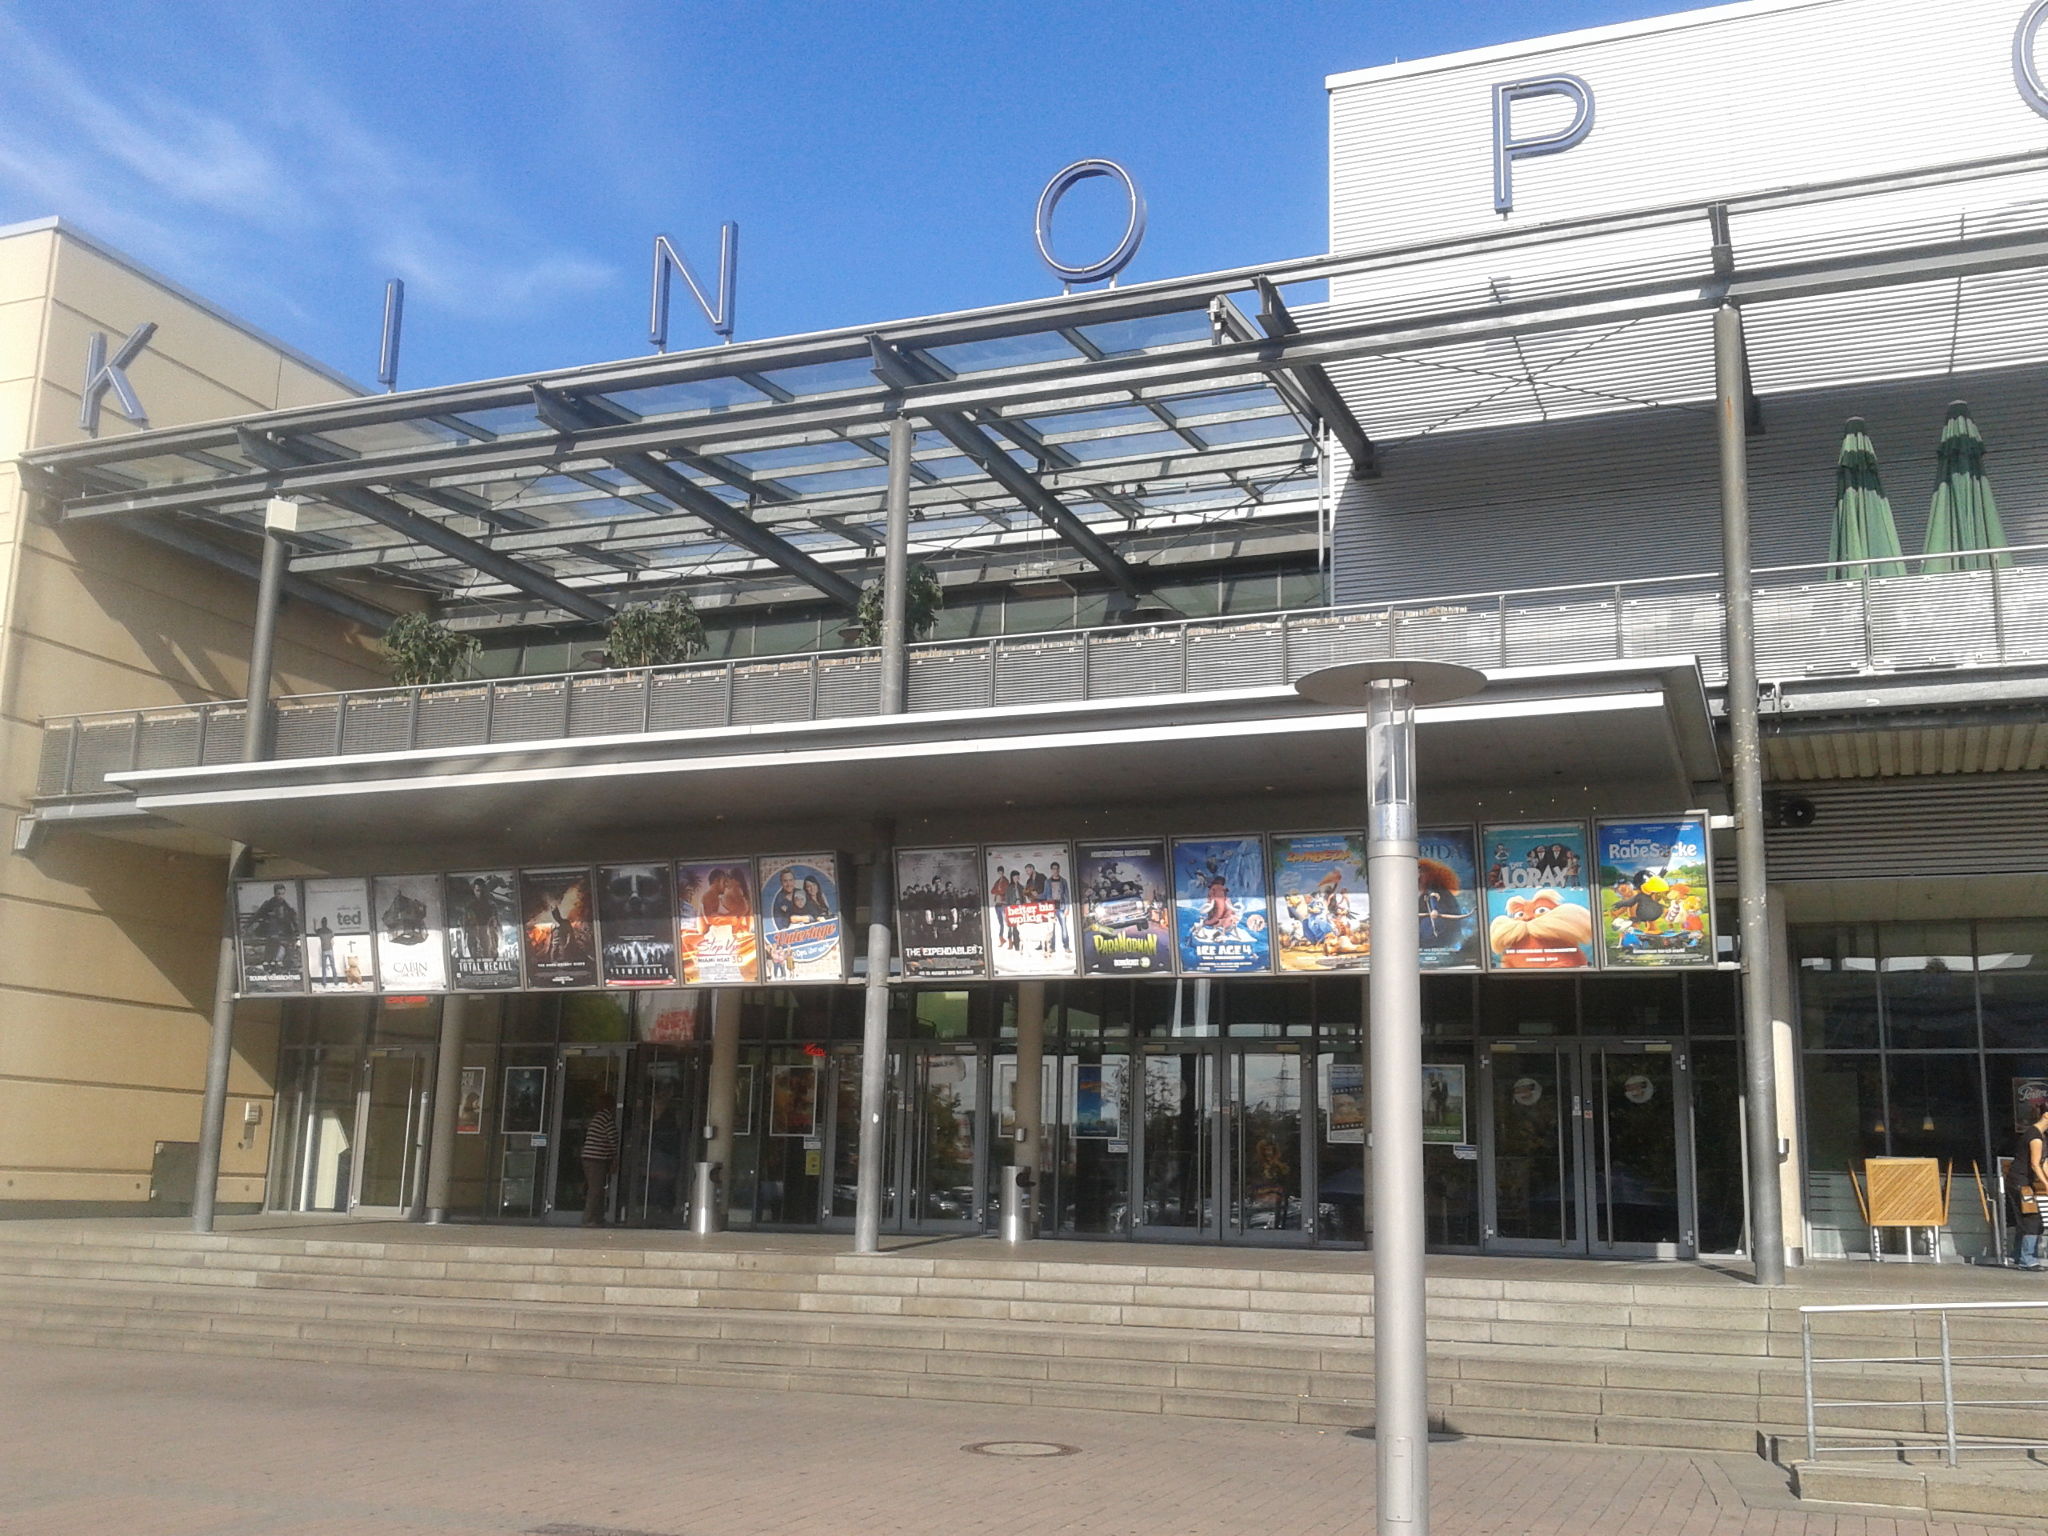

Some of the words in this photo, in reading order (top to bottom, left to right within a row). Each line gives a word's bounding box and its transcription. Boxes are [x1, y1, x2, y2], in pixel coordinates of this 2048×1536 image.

[1501, 864, 1568, 889] LORAX
[336, 911, 362, 926] ted
[905, 948, 921, 957] THE
[1196, 945, 1216, 956] ICE
[1218, 944, 1242, 956] AGE
[1243, 944, 1252, 954] 4
[459, 962, 481, 972] TOTAL
[483, 962, 512, 971] RECALL
